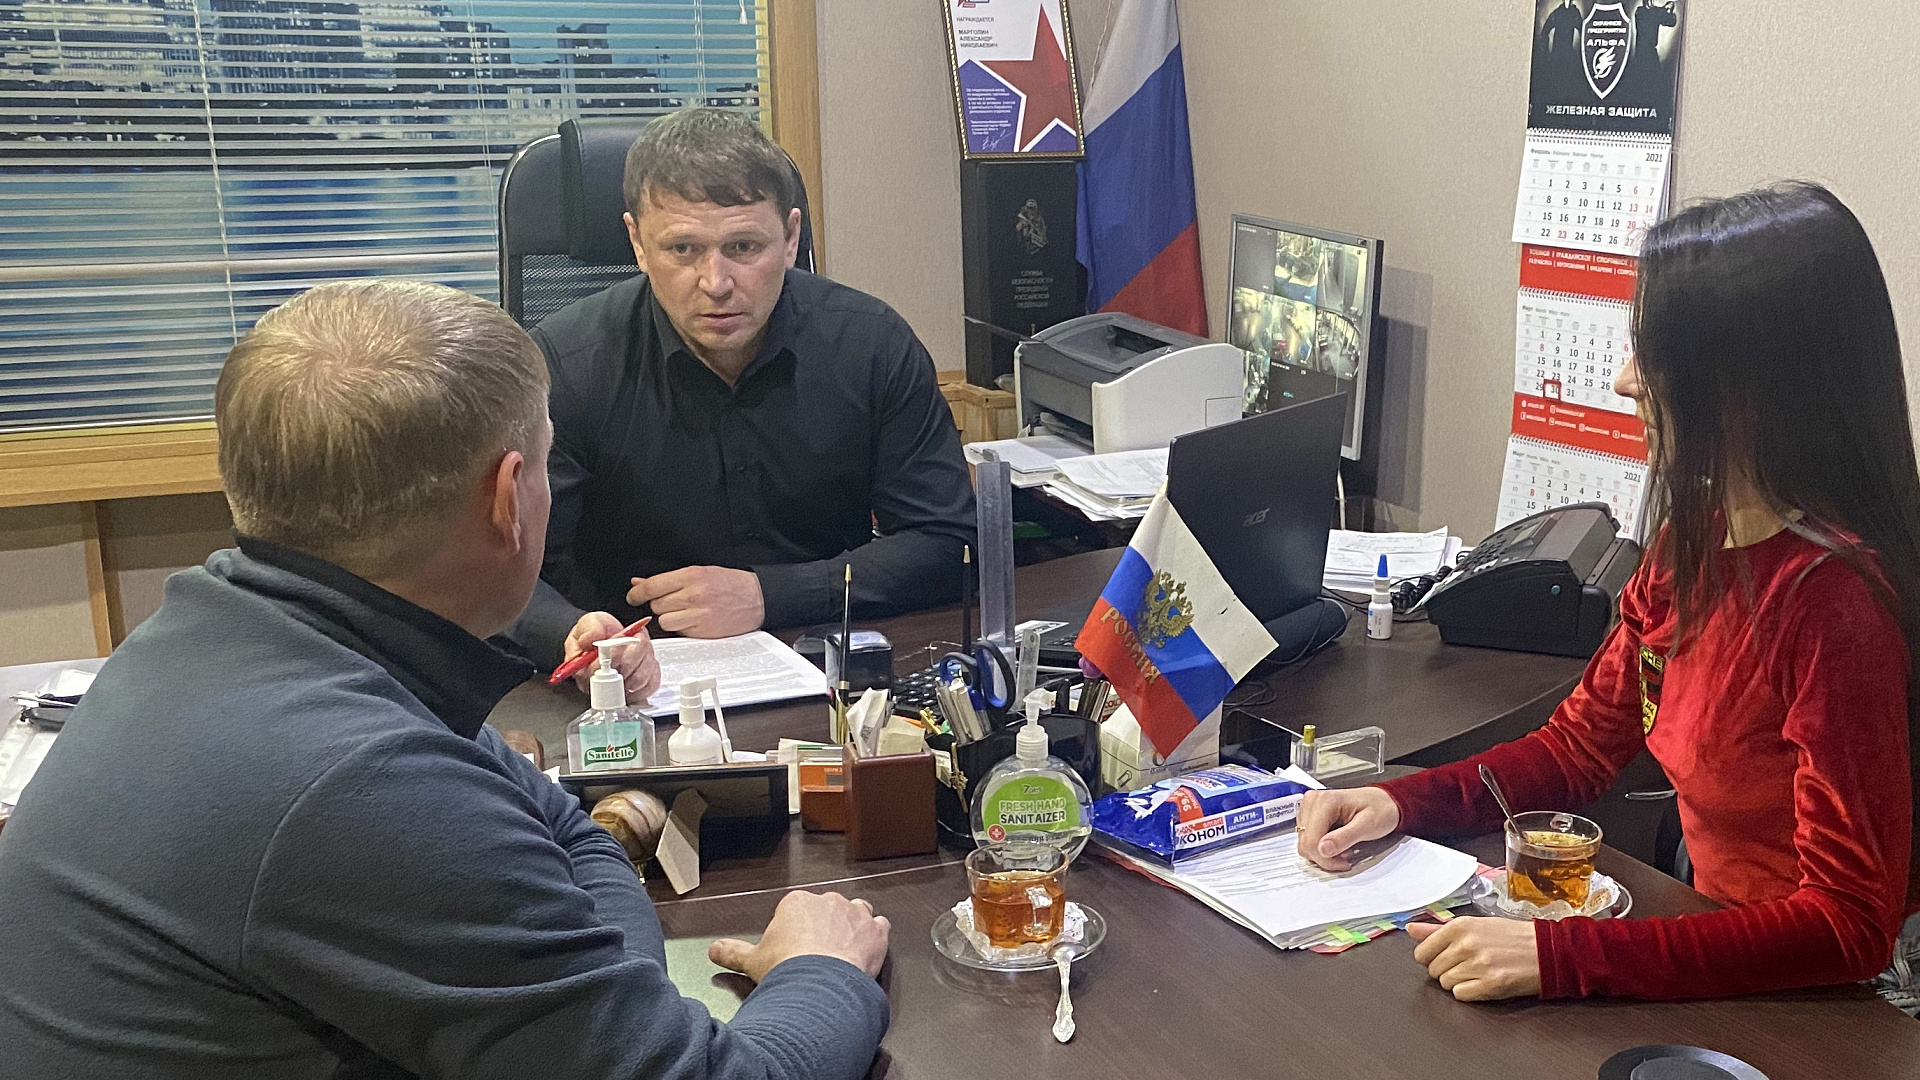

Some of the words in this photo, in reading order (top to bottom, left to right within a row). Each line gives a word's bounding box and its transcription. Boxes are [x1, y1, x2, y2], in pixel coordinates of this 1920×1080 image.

[1586, 38, 1626, 47] АЛЬФА
[1545, 105, 1605, 116] ЖЕЛЕЗНАЯ
[1608, 107, 1657, 118] ЗАЩИТА
[1645, 152, 1663, 163] 2021
[1548, 178, 1553, 187] 1
[1565, 179, 1570, 189] 2
[1581, 181, 1588, 191] 3
[1599, 183, 1605, 192] 4
[1616, 184, 1622, 193] 5
[1633, 185, 1638, 195] 6
[1649, 187, 1655, 197] 7
[1546, 195, 1552, 204] 8
[1563, 196, 1569, 206] 9
[1578, 198, 1589, 208] 10
[1595, 199, 1605, 209] 11
[1612, 201, 1622, 211] 12
[1629, 203, 1639, 213] 13
[1645, 204, 1654, 214] 14
[1542, 212, 1553, 221] 15
[1559, 213, 1569, 223] 16
[1577, 215, 1587, 224] 17
[1594, 216, 1604, 226] 18
[1610, 218, 1620, 228] 19
[1627, 220, 1636, 230] 20
[1540, 227, 1551, 237] 22
[1557, 229, 1568, 240] 23
[1574, 231, 1585, 241] 24
[1592, 233, 1602, 243] 25
[1608, 235, 1618, 245] 26
[1541, 330, 1545, 339] 1
[1556, 332, 1561, 341] 2
[1571, 335, 1577, 344] 3
[1589, 338, 1594, 346] 4
[1606, 340, 1612, 349] 5
[1539, 343, 1545, 352] 8
[1555, 345, 1560, 355] 9
[1569, 348, 1579, 358] 10
[1586, 351, 1595, 360] 11
[1603, 354, 1613, 364] 12
[1537, 356, 1546, 365] 15
[1552, 359, 1562, 368] 16
[1568, 362, 1578, 371] 17
[1585, 364, 1595, 374] 18
[1601, 367, 1612, 377] 19
[1536, 369, 1545, 379] 22
[1567, 374, 1577, 385] 24
[1584, 377, 1594, 388] 25
[1600, 381, 1611, 391] 26
[1566, 388, 1575, 398] 31
[1624, 471, 1641, 483] 2021
[1531, 476, 1536, 484] 1
[1547, 479, 1552, 488] 2
[1562, 482, 1568, 492] 3
[1579, 487, 1585, 495] 4
[1596, 490, 1601, 499] 5
[1612, 494, 1618, 504] 6
[1628, 498, 1634, 508] 7
[1526, 501, 1536, 510] 15
[1529, 488, 1535, 497] 8
[1546, 492, 1551, 501] 9
[1560, 495, 1570, 505] 10
[1624, 511, 1633, 522] 14
[1100, 606, 1161, 685] РОССИЯ
[588, 747, 634, 760] Sanitelle
[1000, 801, 1033, 812] FRESH
[1037, 799, 1065, 811] HAND
[1000, 810, 1066, 824] SANITAIZER
[1202, 816, 1224, 829] smart
[1233, 811, 1259, 824] АНТИ-
